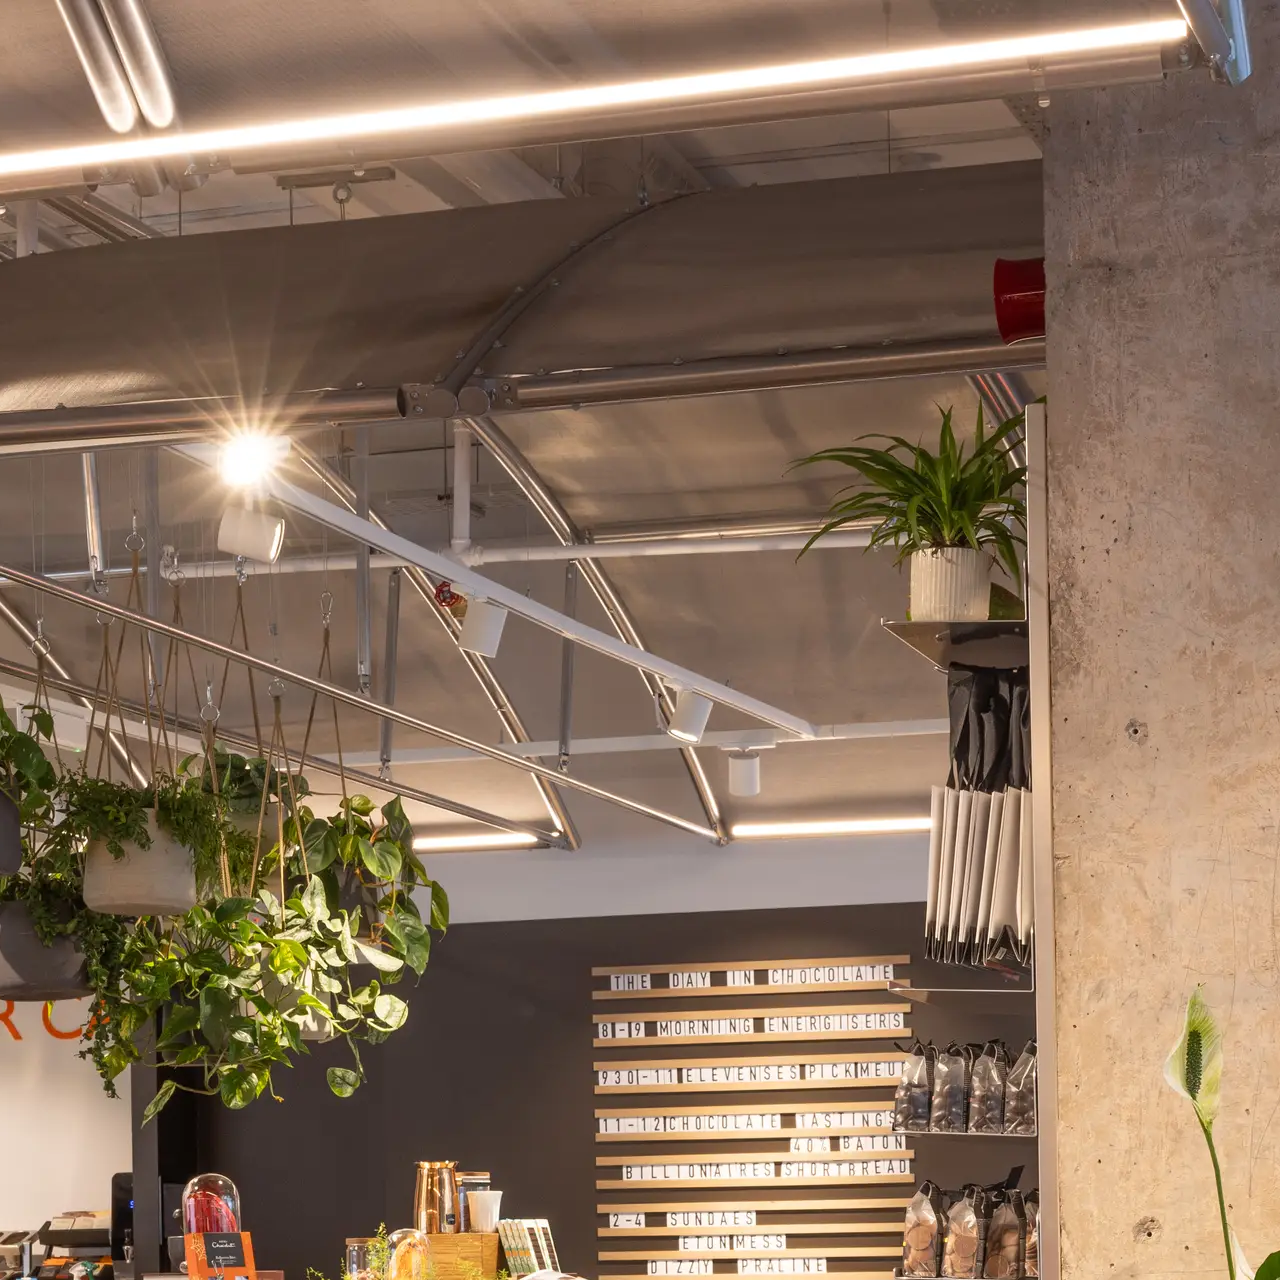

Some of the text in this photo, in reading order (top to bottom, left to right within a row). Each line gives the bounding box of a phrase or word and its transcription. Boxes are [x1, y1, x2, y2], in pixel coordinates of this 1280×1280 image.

[614, 965, 890, 990] THE DAY IN CHOCOLATE
[602, 1013, 901, 1038] 8-9 MORNING ENERGISERS
[686, 1064, 797, 1082] ELEVENSES
[809, 1062, 852, 1078] PICK
[860, 1060, 904, 1078] MEU
[602, 1116, 661, 1132] 11-12
[670, 1114, 778, 1130] CHOCOLATE
[844, 1136, 903, 1150] BATON
[626, 1160, 907, 1180] BILLIONAIRES SHORTBREAD
[613, 1211, 753, 1227] 2-4 SUNDAES
[683, 1235, 784, 1250] ETON MESS
[651, 1258, 824, 1274] DIZZY PRALINE
